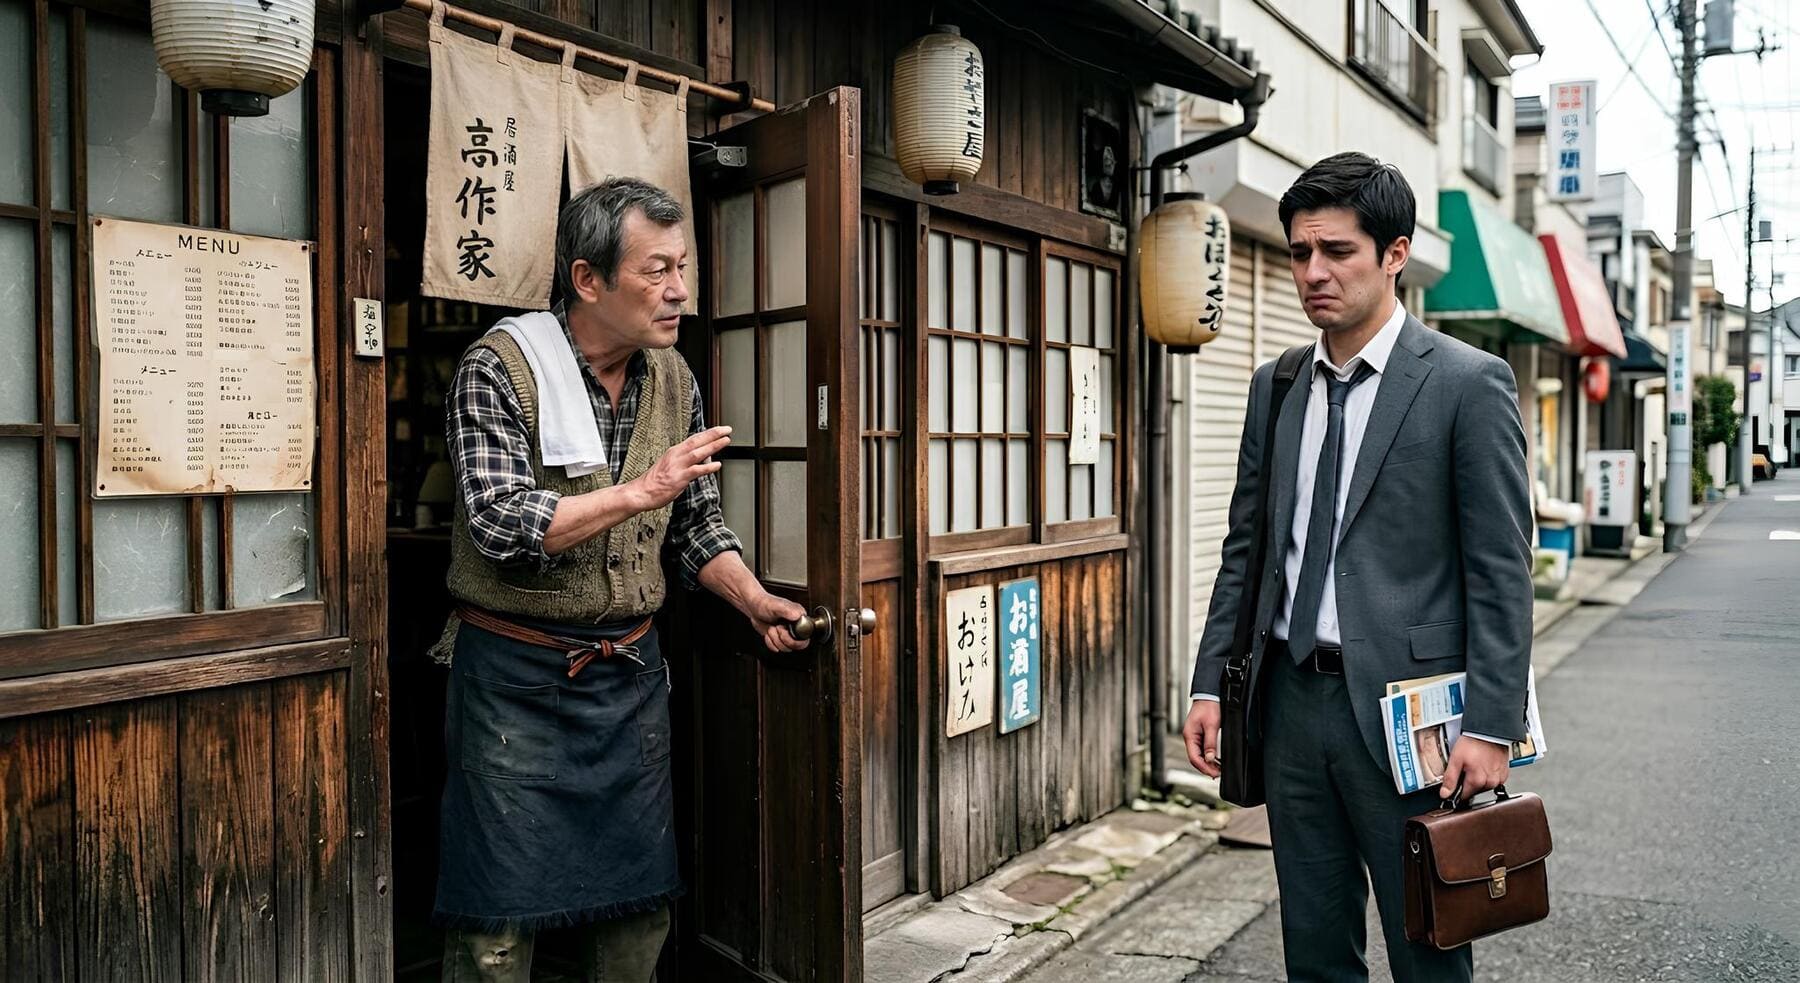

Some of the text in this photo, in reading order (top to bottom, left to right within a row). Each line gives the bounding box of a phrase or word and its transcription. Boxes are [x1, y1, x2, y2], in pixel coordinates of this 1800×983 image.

[178, 234, 240, 255] MENU
[455, 117, 499, 282] 高作家
